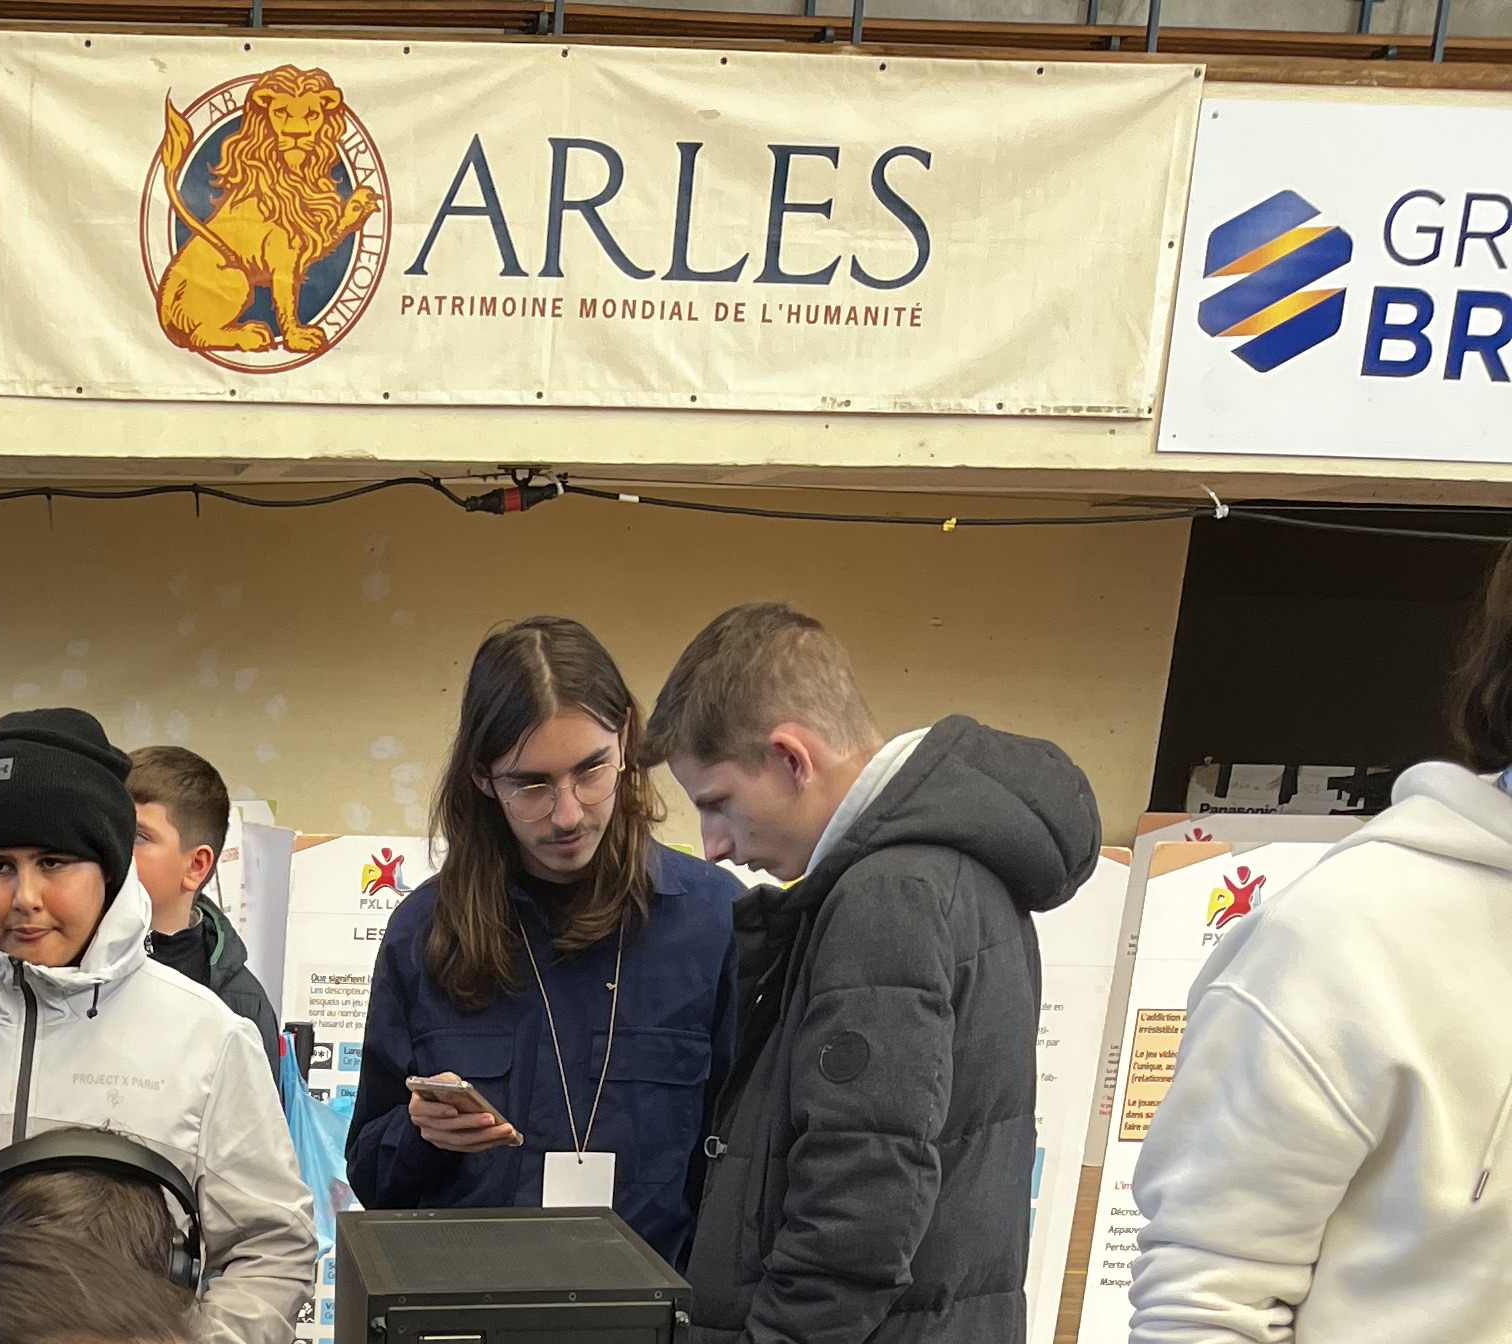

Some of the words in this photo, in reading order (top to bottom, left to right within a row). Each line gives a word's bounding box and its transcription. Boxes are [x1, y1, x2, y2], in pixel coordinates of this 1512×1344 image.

[404, 132, 934, 290] ARLES
[400, 295, 564, 318] PATRIMOINE
[579, 298, 699, 321] MONDIAL
[714, 302, 746, 323] DE
[761, 302, 923, 327] L'HUMANITÉ
[1199, 802, 1278, 814] Panasonic
[360, 899, 383, 910] PXL
[1202, 932, 1224, 947] PX
[311, 973, 326, 983] Que
[329, 973, 365, 984] signifient
[325, 986, 369, 996] descripteur
[309, 1008, 325, 1017] sont
[1140, 1012, 1180, 1022] L'addiction
[73, 1073, 119, 1085] PROJECT
[122, 1076, 128, 1087] X
[1108, 1225, 1139, 1236] Appauv
[1105, 1243, 1139, 1251] Perturb
[1103, 1260, 1125, 1268] Perte
